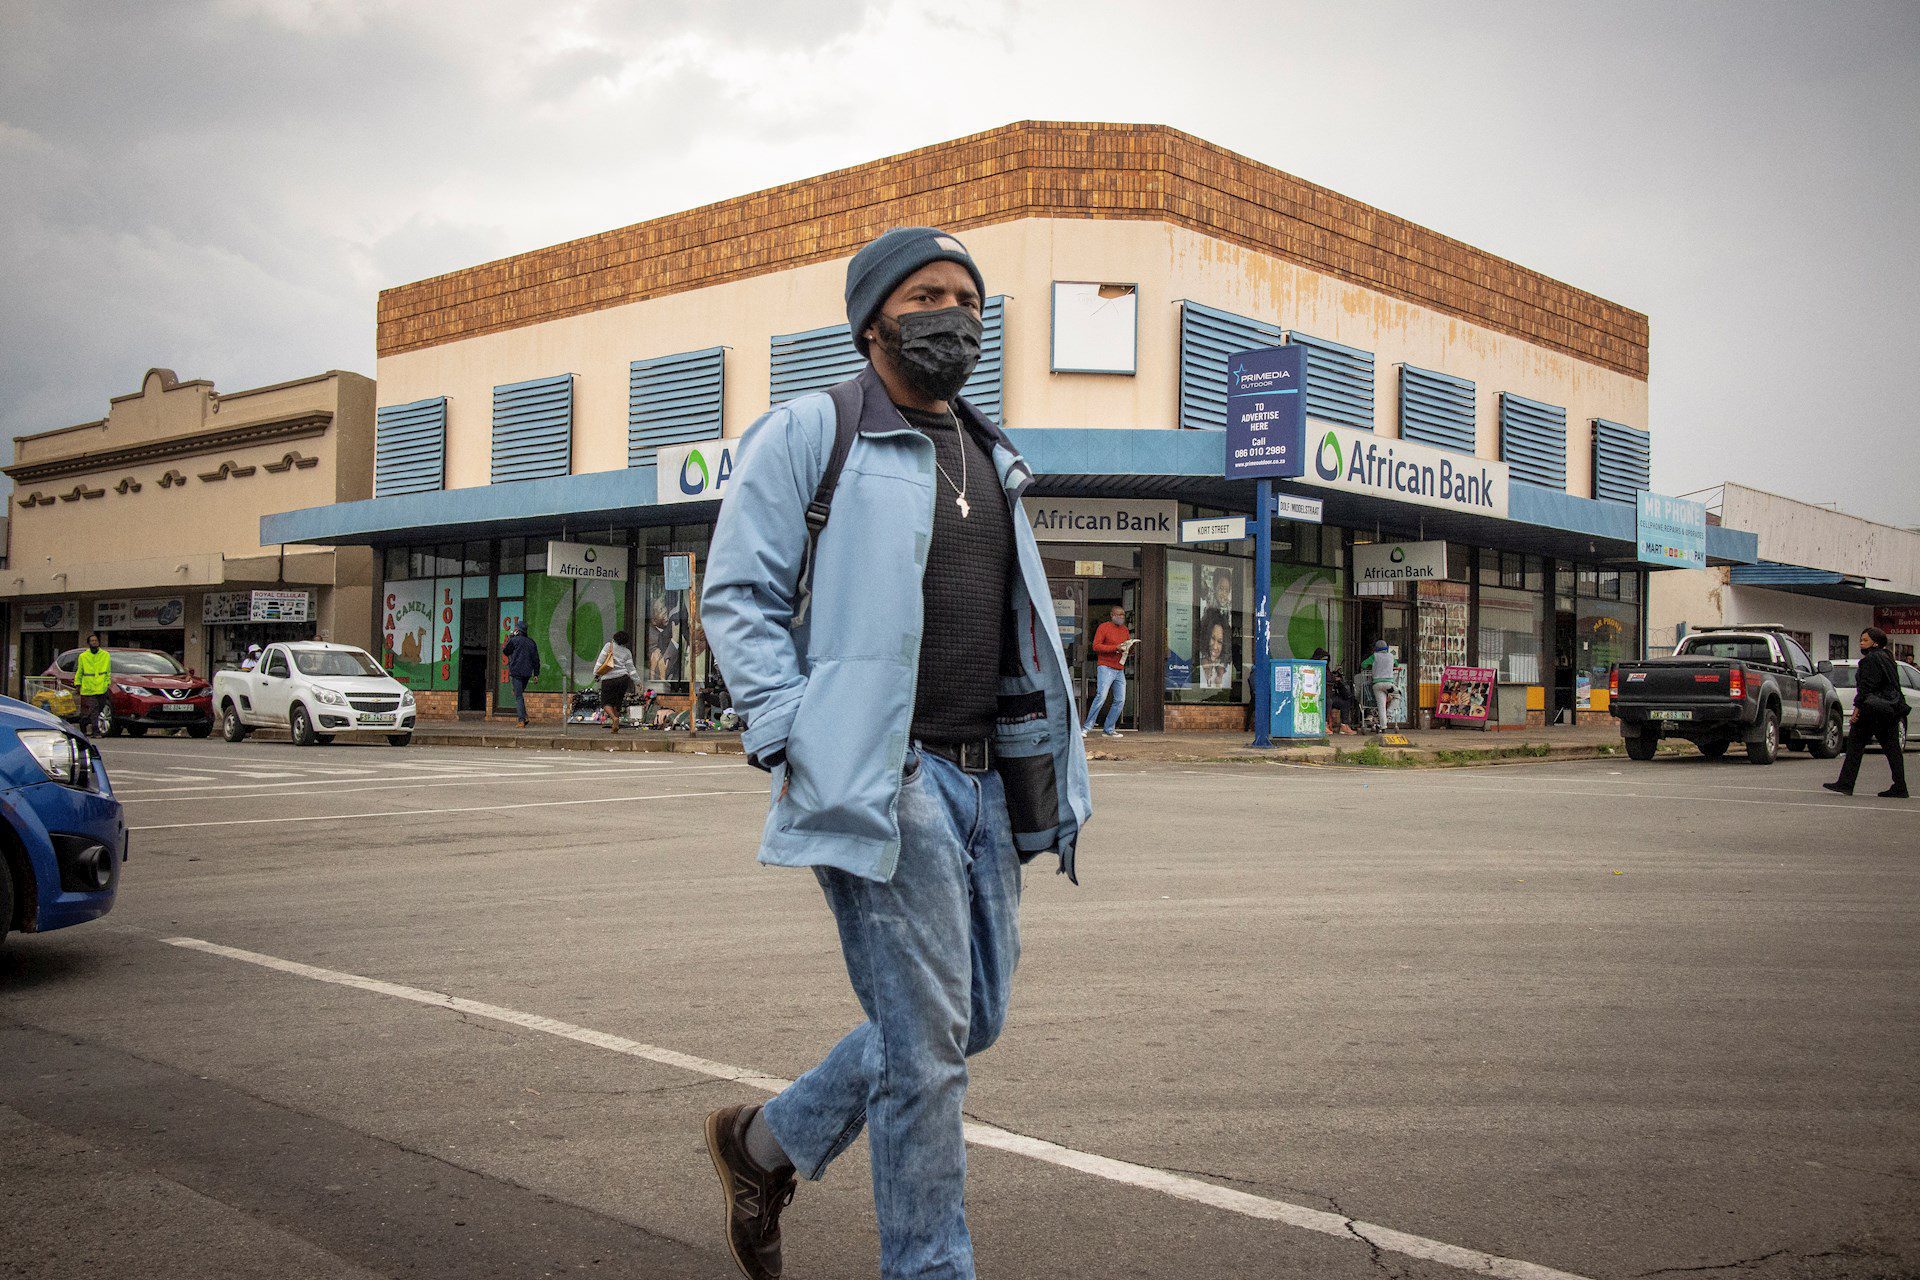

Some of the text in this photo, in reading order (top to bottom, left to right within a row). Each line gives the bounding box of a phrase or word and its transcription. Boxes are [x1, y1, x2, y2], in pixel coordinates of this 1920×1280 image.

[1240, 370, 1290, 382] PRIMEDIA
[1241, 381, 1273, 389] OUTDOOR
[1255, 403, 1264, 411] TO
[1241, 411, 1279, 423] ADVERTISE
[1250, 422, 1269, 432] HERE
[1252, 437, 1266, 447] Call
[1235, 446, 1286, 458] 086 010 2989
[1347, 440, 1493, 508] African Bank
[1645, 496, 1703, 526] MR PHONE
[1033, 509, 1170, 531] African Bank
[1197, 524, 1230, 535] KORT STREET
[560, 563, 620, 578] African Bank
[1364, 565, 1434, 579] African Bank
[395, 601, 433, 622] CAMELA
[384, 593, 396, 669] CASH
[441, 588, 453, 681] LOANS
